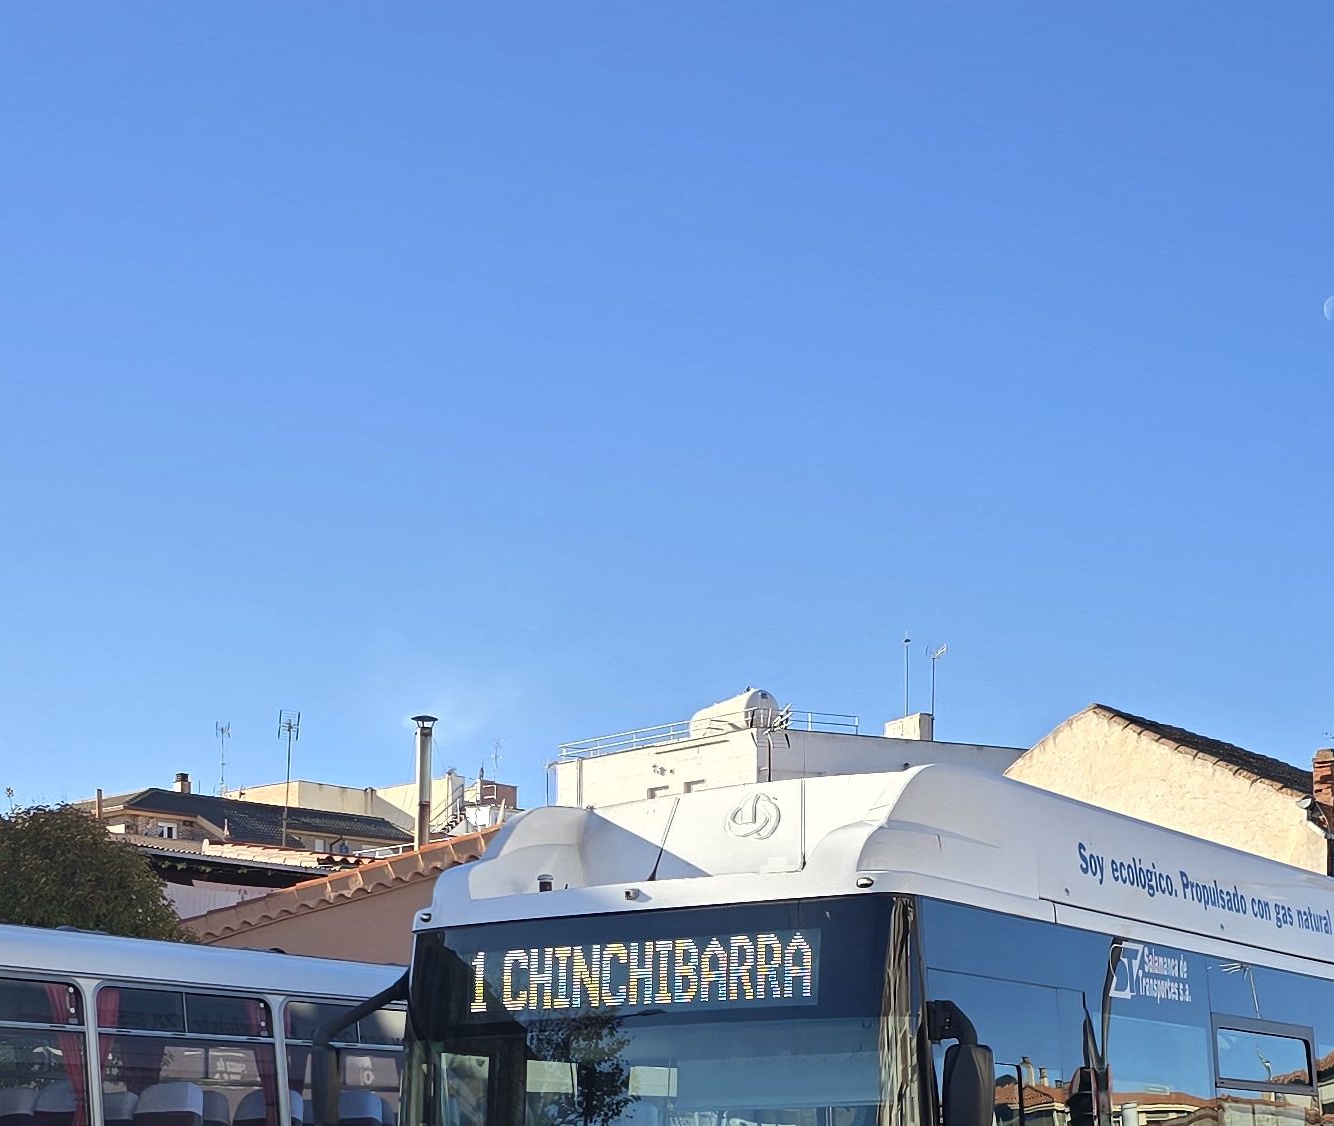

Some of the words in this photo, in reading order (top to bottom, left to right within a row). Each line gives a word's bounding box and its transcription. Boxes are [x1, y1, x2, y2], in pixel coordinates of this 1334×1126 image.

[1078, 842, 1105, 885] Soy
[1111, 857, 1178, 898] ecológico.
[1179, 870, 1247, 915] Propulsado
[1251, 897, 1272, 921] con
[1275, 903, 1294, 929] gas
[1297, 906, 1333, 936] natural
[470, 951, 488, 1013] 1
[502, 931, 813, 1012] CHINCHIBARRA
[1138, 969, 1179, 1004] Transportes
[1143, 946, 1179, 979] Salamanca
[1179, 953, 1188, 979] de
